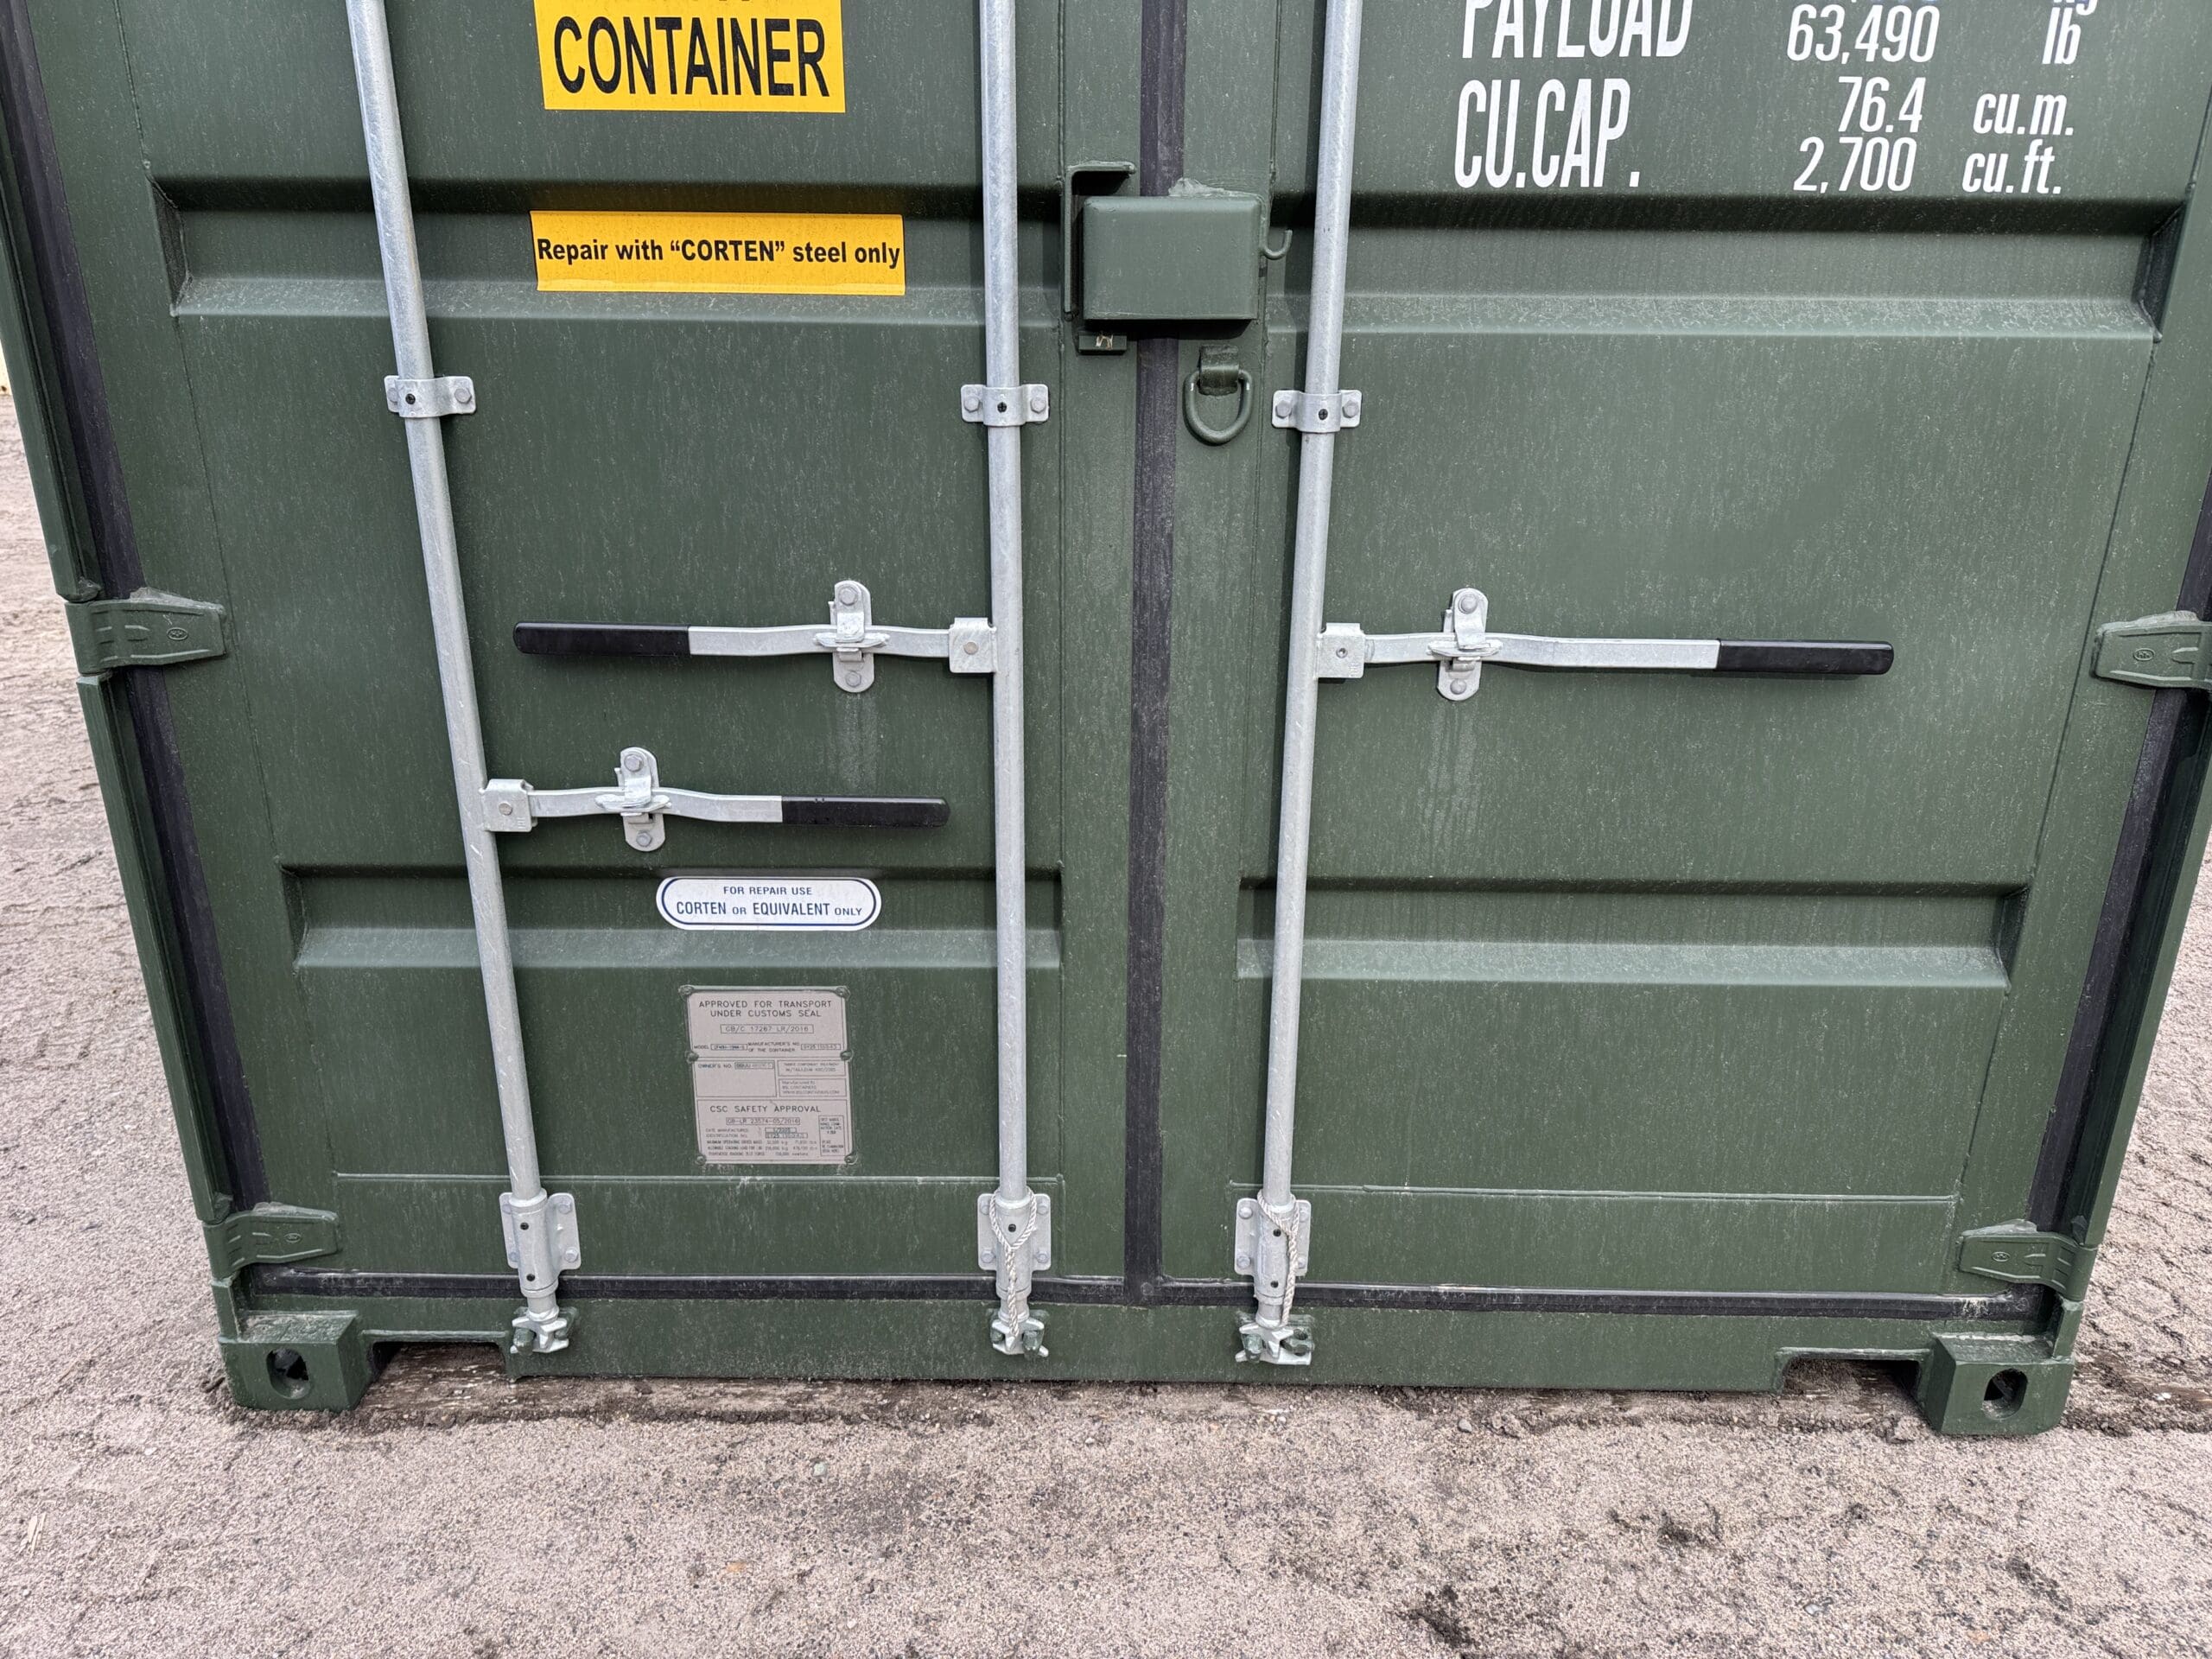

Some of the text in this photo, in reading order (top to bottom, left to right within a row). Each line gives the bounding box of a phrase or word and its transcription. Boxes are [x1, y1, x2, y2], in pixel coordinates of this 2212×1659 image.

[554, 16, 830, 97] CONTAINER
[1787, 4, 2081, 65] 63,490 lb
[1838, 76, 1926, 133] 76.4
[1973, 93, 2074, 135] cu.m.
[1793, 137, 2062, 194] 2,700 cu.ft.
[537, 238, 608, 264] Repair
[615, 239, 663, 260] with
[792, 242, 847, 263] steel
[855, 242, 900, 269] only
[677, 901, 862, 916] CORTEN OR EQUIVALENT ONLY
[723, 886, 812, 895] FOR REPAIR USE
[698, 1000, 748, 1008] APPROVED
